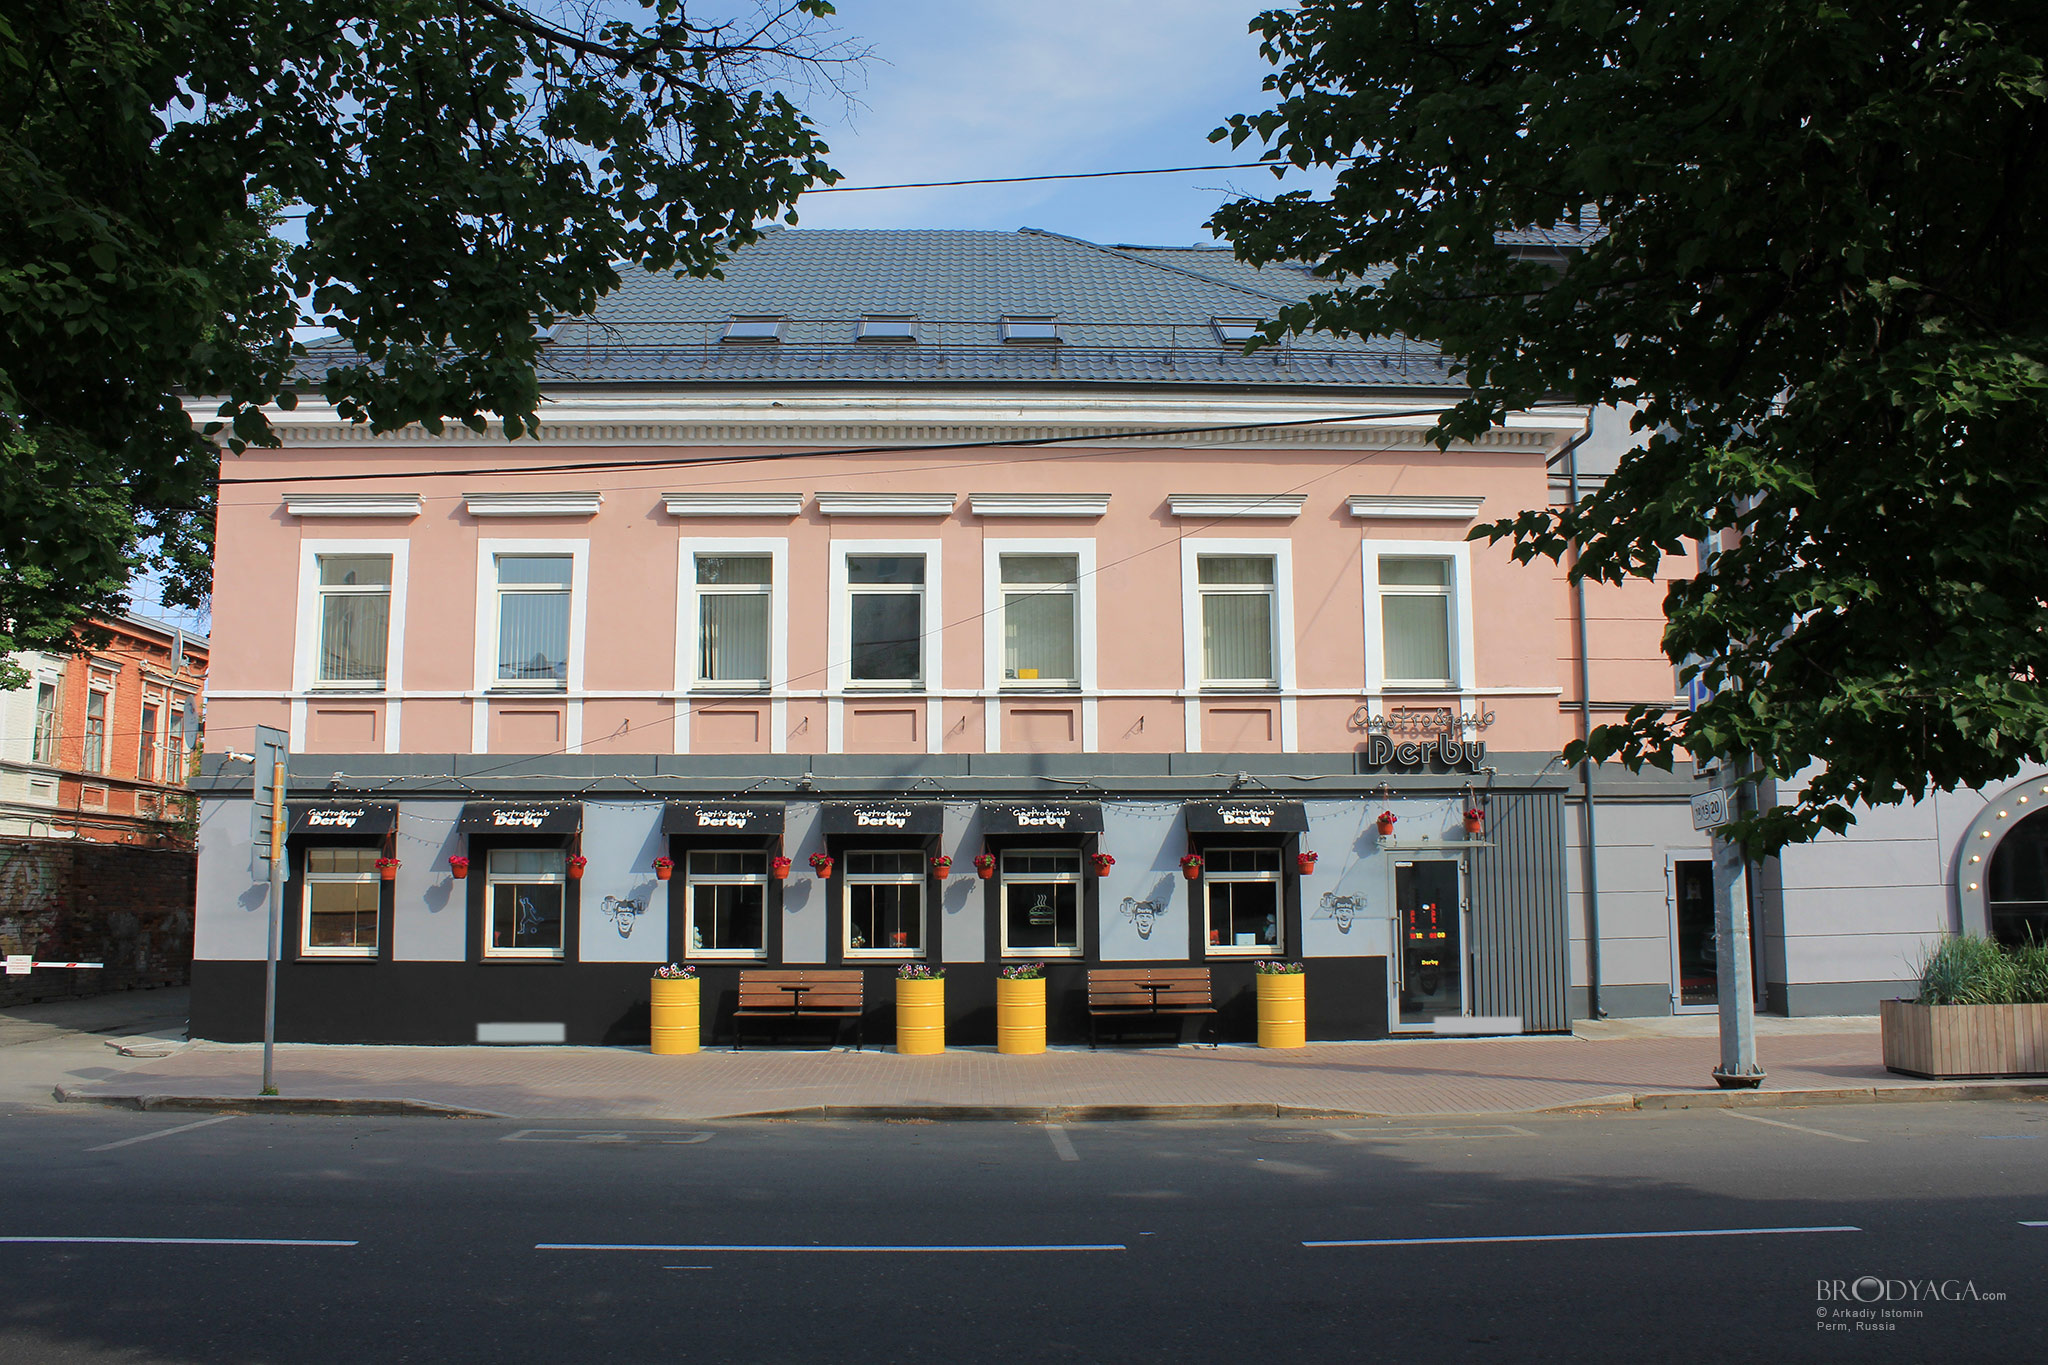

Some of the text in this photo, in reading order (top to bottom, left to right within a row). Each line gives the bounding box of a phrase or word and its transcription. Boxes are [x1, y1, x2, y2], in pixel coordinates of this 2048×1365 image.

[1368, 732, 1487, 772] Derby
[1710, 801, 1719, 814] 20
[308, 815, 357, 828] Derby
[494, 815, 543, 828] Derby
[698, 815, 747, 829] Derby
[857, 815, 906, 829] Derby
[1018, 815, 1066, 829] Derby
[1223, 814, 1270, 827] Derby
